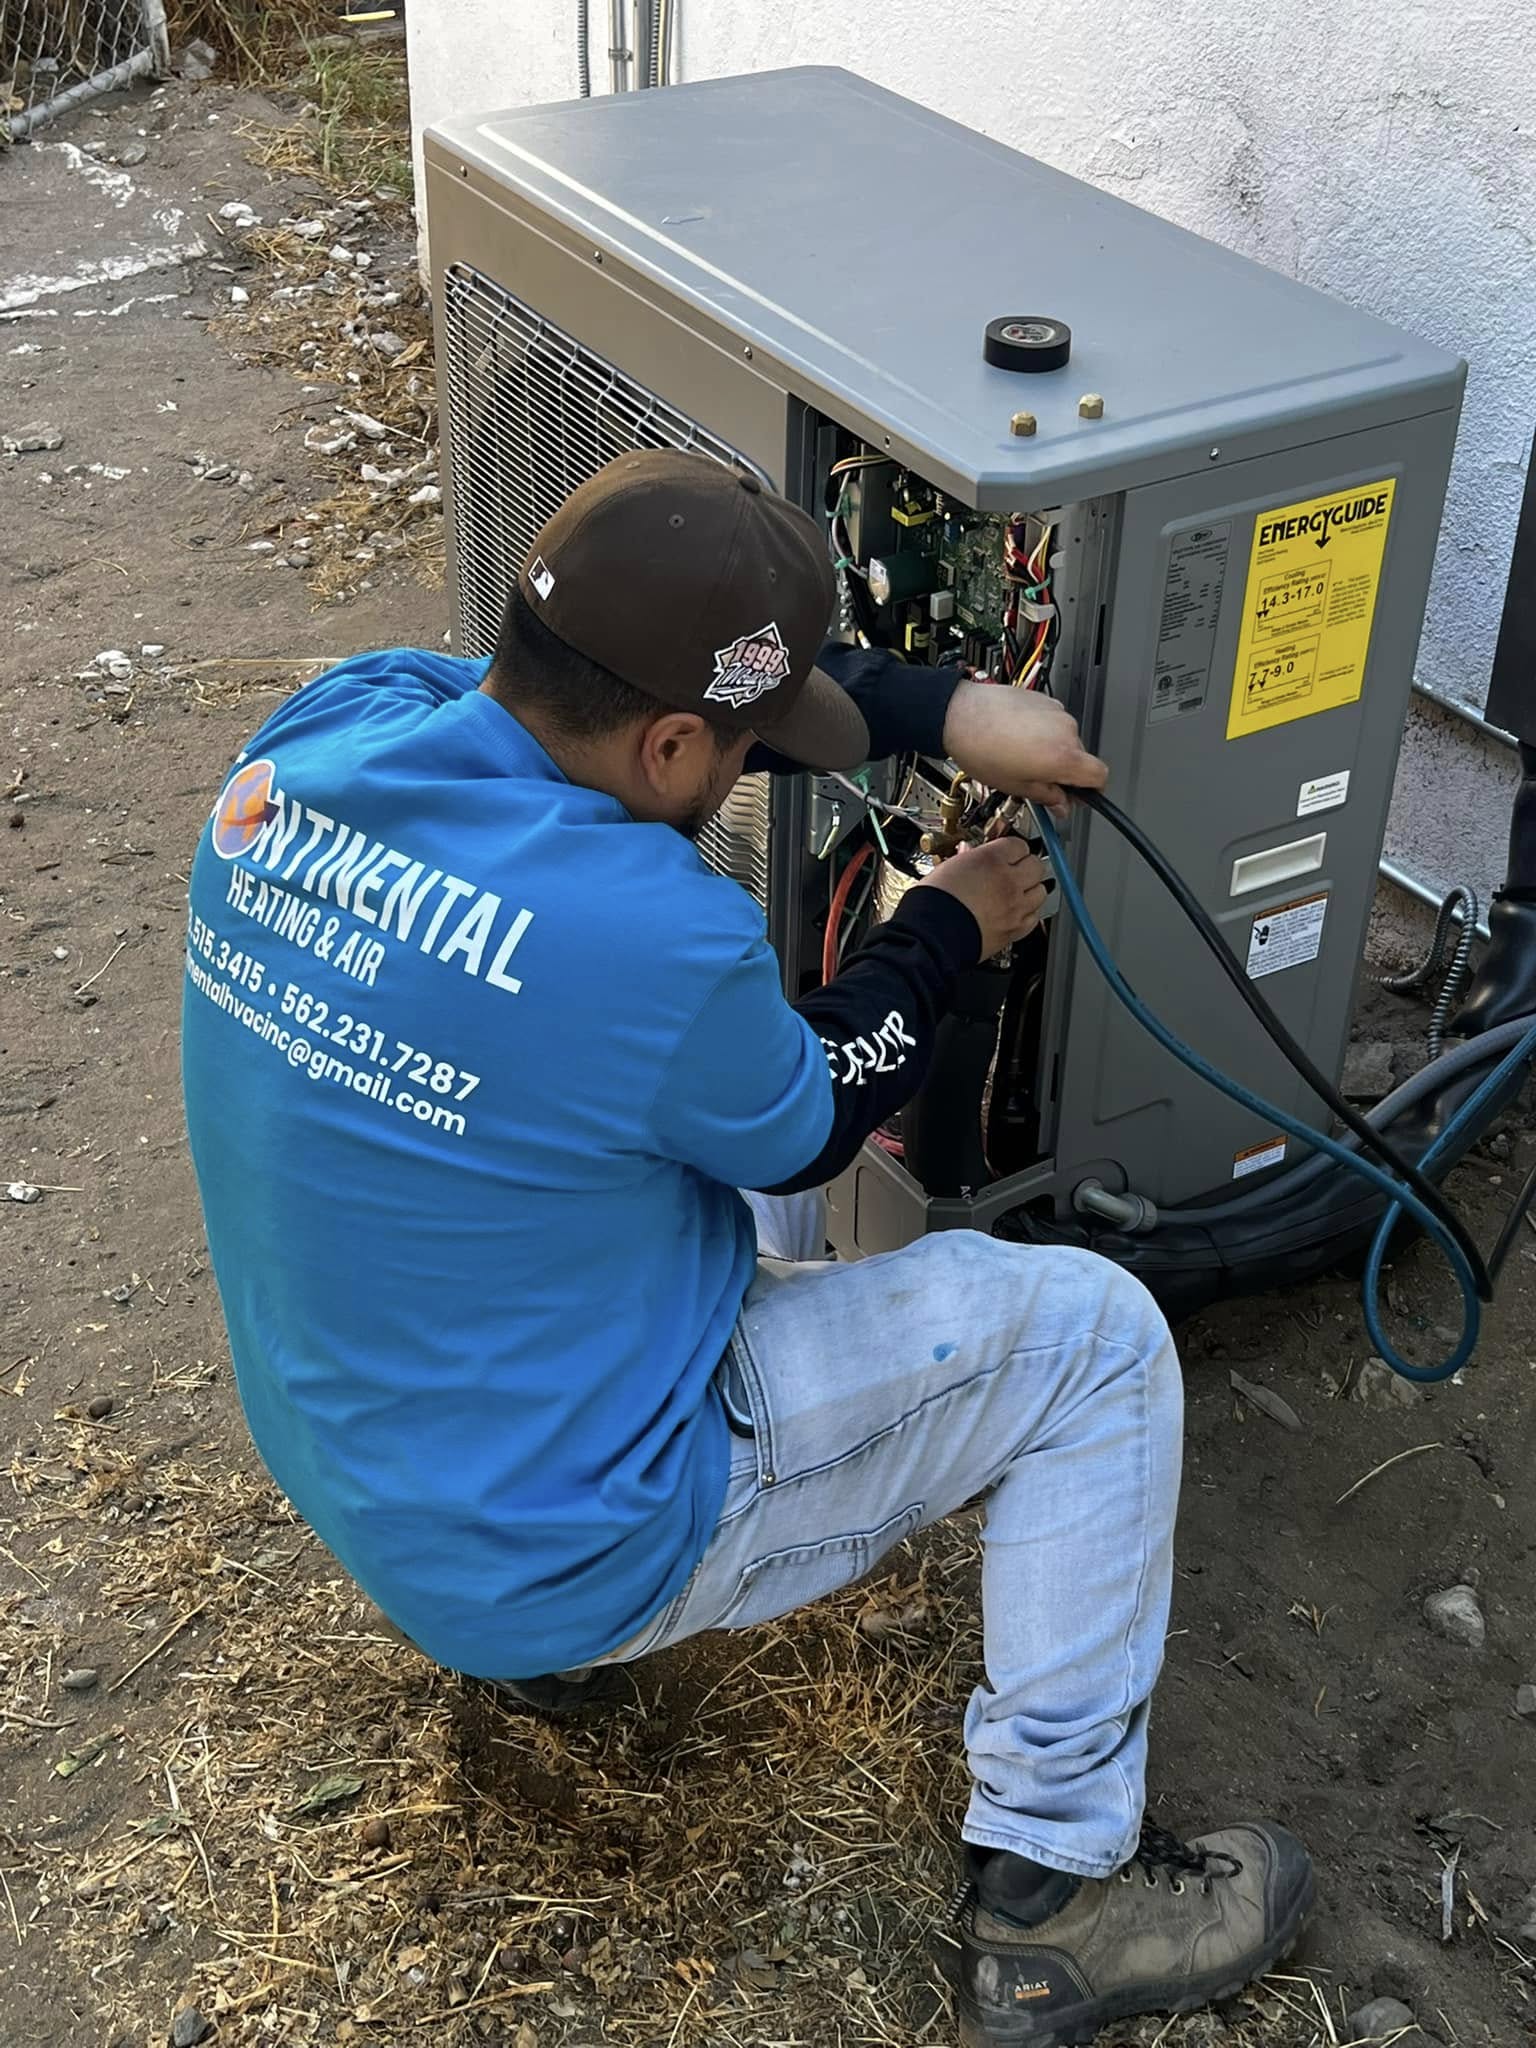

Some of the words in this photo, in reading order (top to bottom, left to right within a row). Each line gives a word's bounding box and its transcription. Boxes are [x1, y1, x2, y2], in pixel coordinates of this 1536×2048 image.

[1258, 493, 1388, 548] ENERGYGUIDE
[731, 641, 785, 673] 1999
[226, 863, 320, 949] HEATING
[314, 916, 341, 961] &
[333, 930, 386, 987] AIR
[188, 907, 267, 993] .515.3415
[281, 983, 481, 1102] 562.231.7287
[1015, 1980, 1049, 1992] ARIAT
